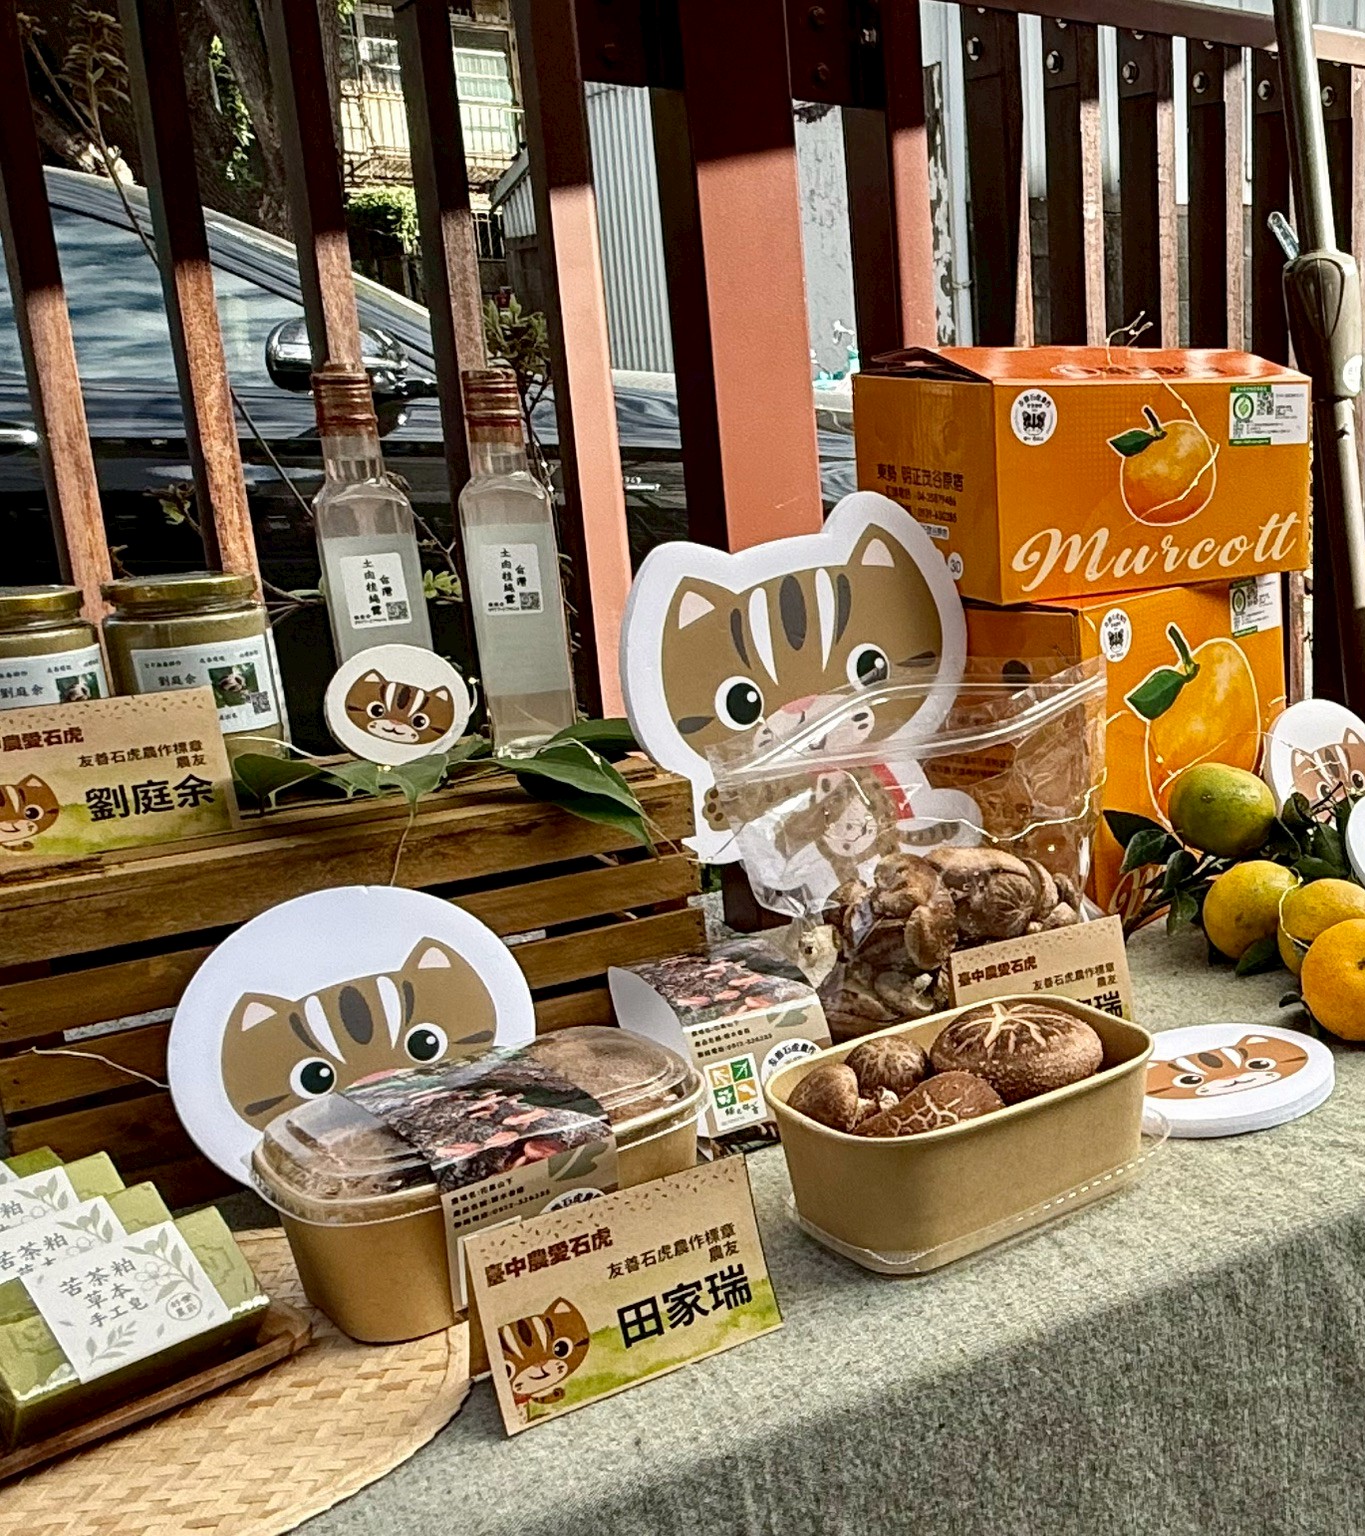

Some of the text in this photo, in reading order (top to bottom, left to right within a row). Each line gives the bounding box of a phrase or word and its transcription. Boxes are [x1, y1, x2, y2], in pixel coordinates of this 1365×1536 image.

[1011, 511, 1302, 592] Murcott
[0, 726, 84, 751] 農愛石虎
[78, 740, 203, 768] 友善石虎農作標章
[176, 754, 207, 769] 農友
[85, 773, 215, 822] 劉庭余
[957, 956, 1038, 988] 臺中農愛石虎
[1032, 962, 1115, 991] 友善石虎農作標章
[1097, 974, 1118, 989] 農友
[484, 1227, 614, 1288] 臺中農愛石虎
[607, 1222, 736, 1280] 友善石虎農作標章
[709, 1239, 740, 1263] 農友
[58, 1257, 137, 1298] 苦茶粕
[83, 1282, 135, 1310] 草本
[89, 1296, 149, 1328] 手工皂
[616, 1262, 753, 1350] 田家瑞
